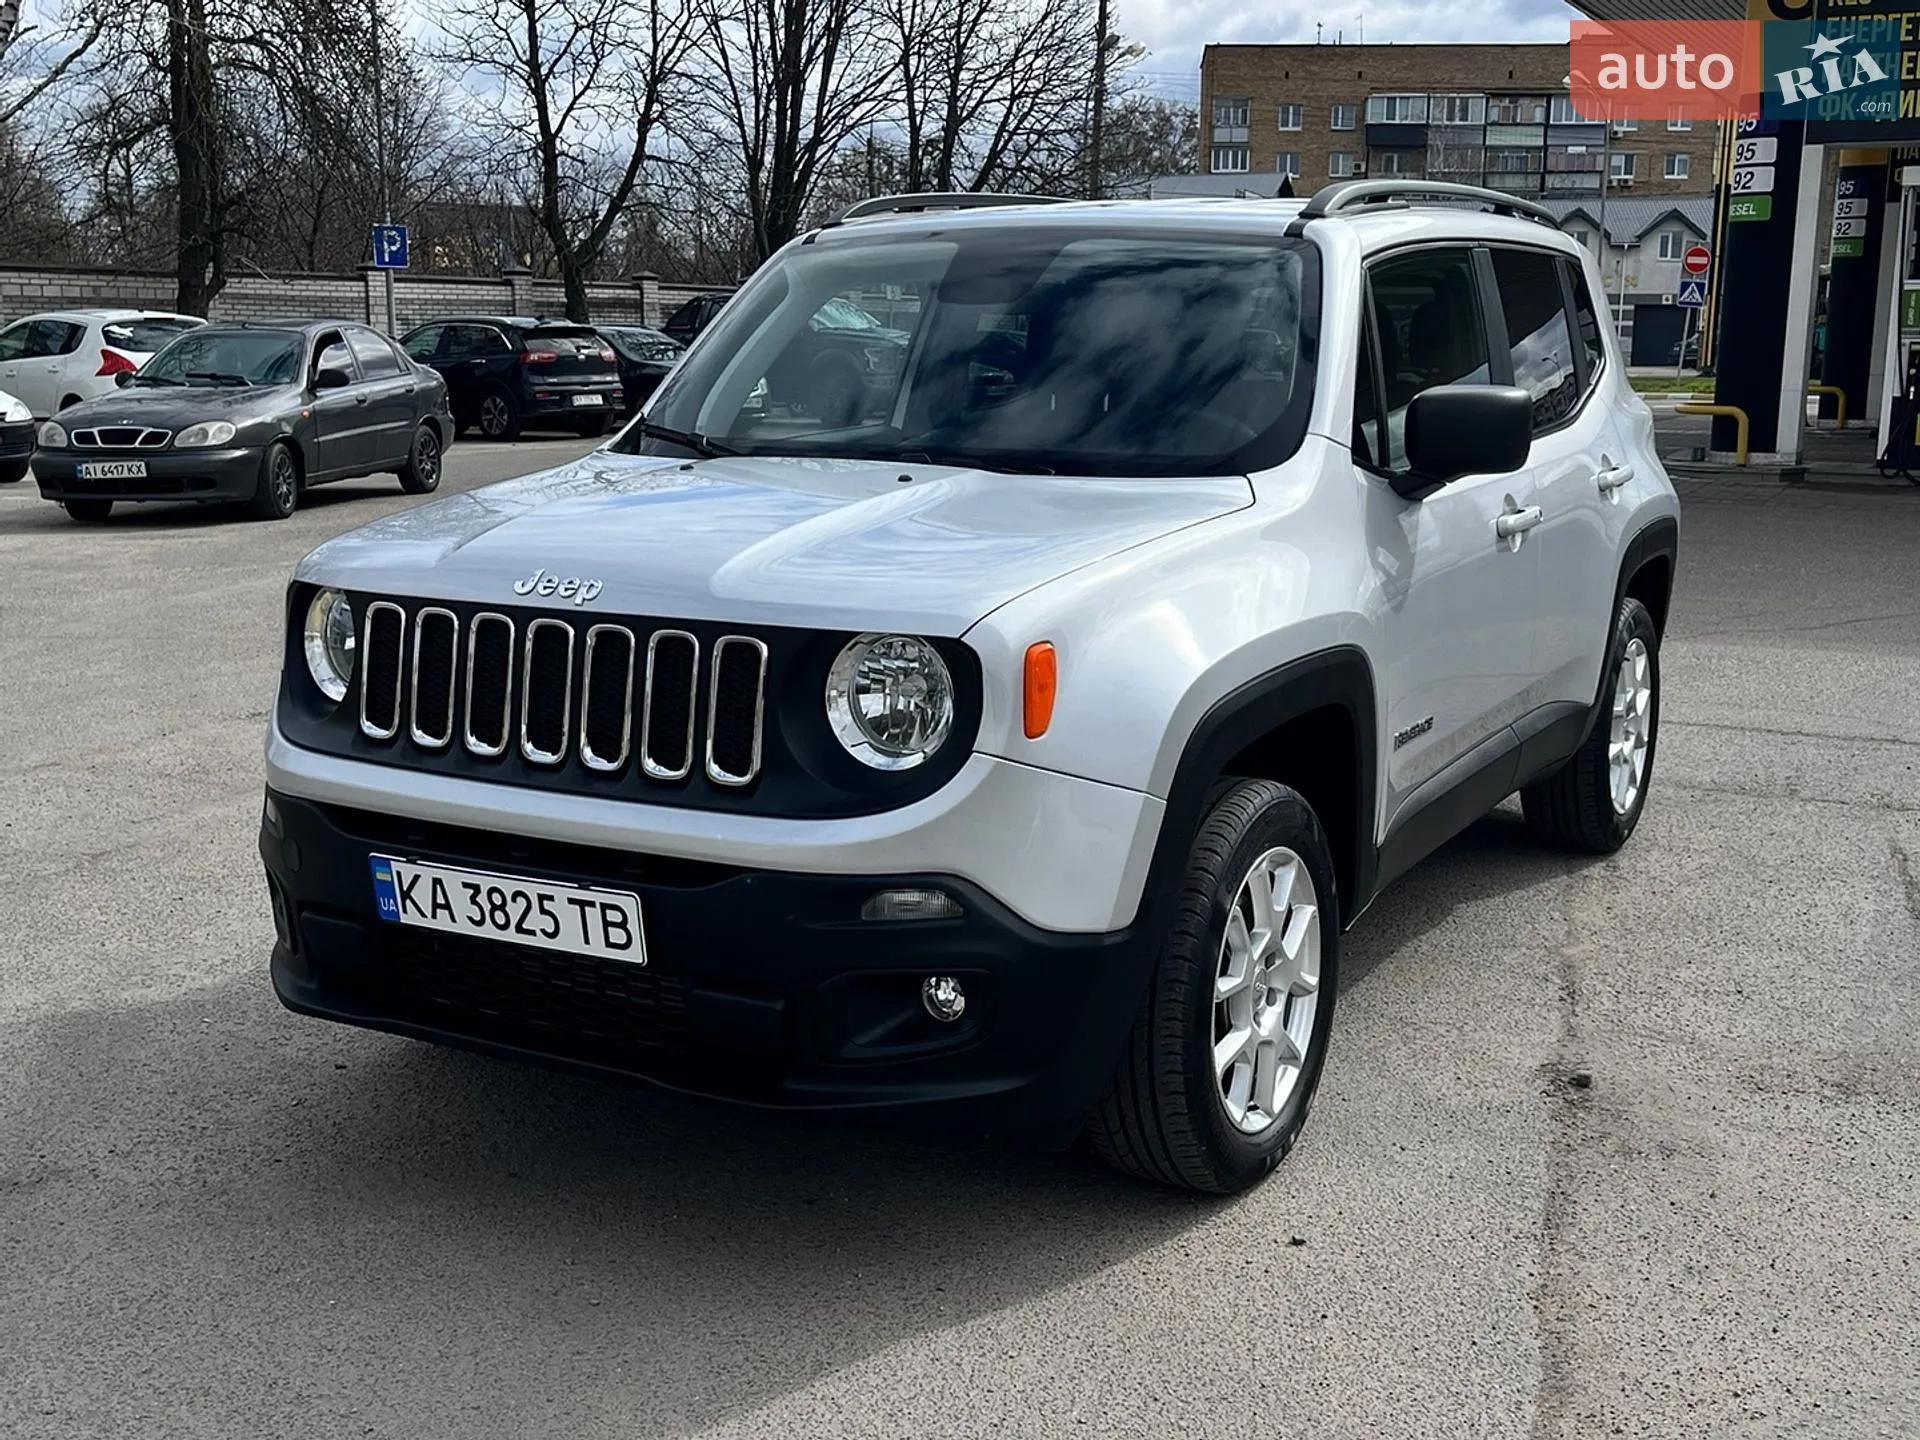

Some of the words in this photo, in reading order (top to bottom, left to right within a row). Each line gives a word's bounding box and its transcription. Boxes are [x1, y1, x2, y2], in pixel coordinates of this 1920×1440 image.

[1736, 142, 1757, 162] 95
[1733, 171, 1754, 190] 92
[1840, 181, 1855, 195] 95
[1837, 202, 1853, 215] 95
[1836, 223, 1851, 236] 92
[513, 568, 604, 605] Jeep
[380, 896, 397, 912] UA
[395, 870, 457, 924] KA
[461, 881, 561, 940] 3825
[567, 897, 633, 951] TB
